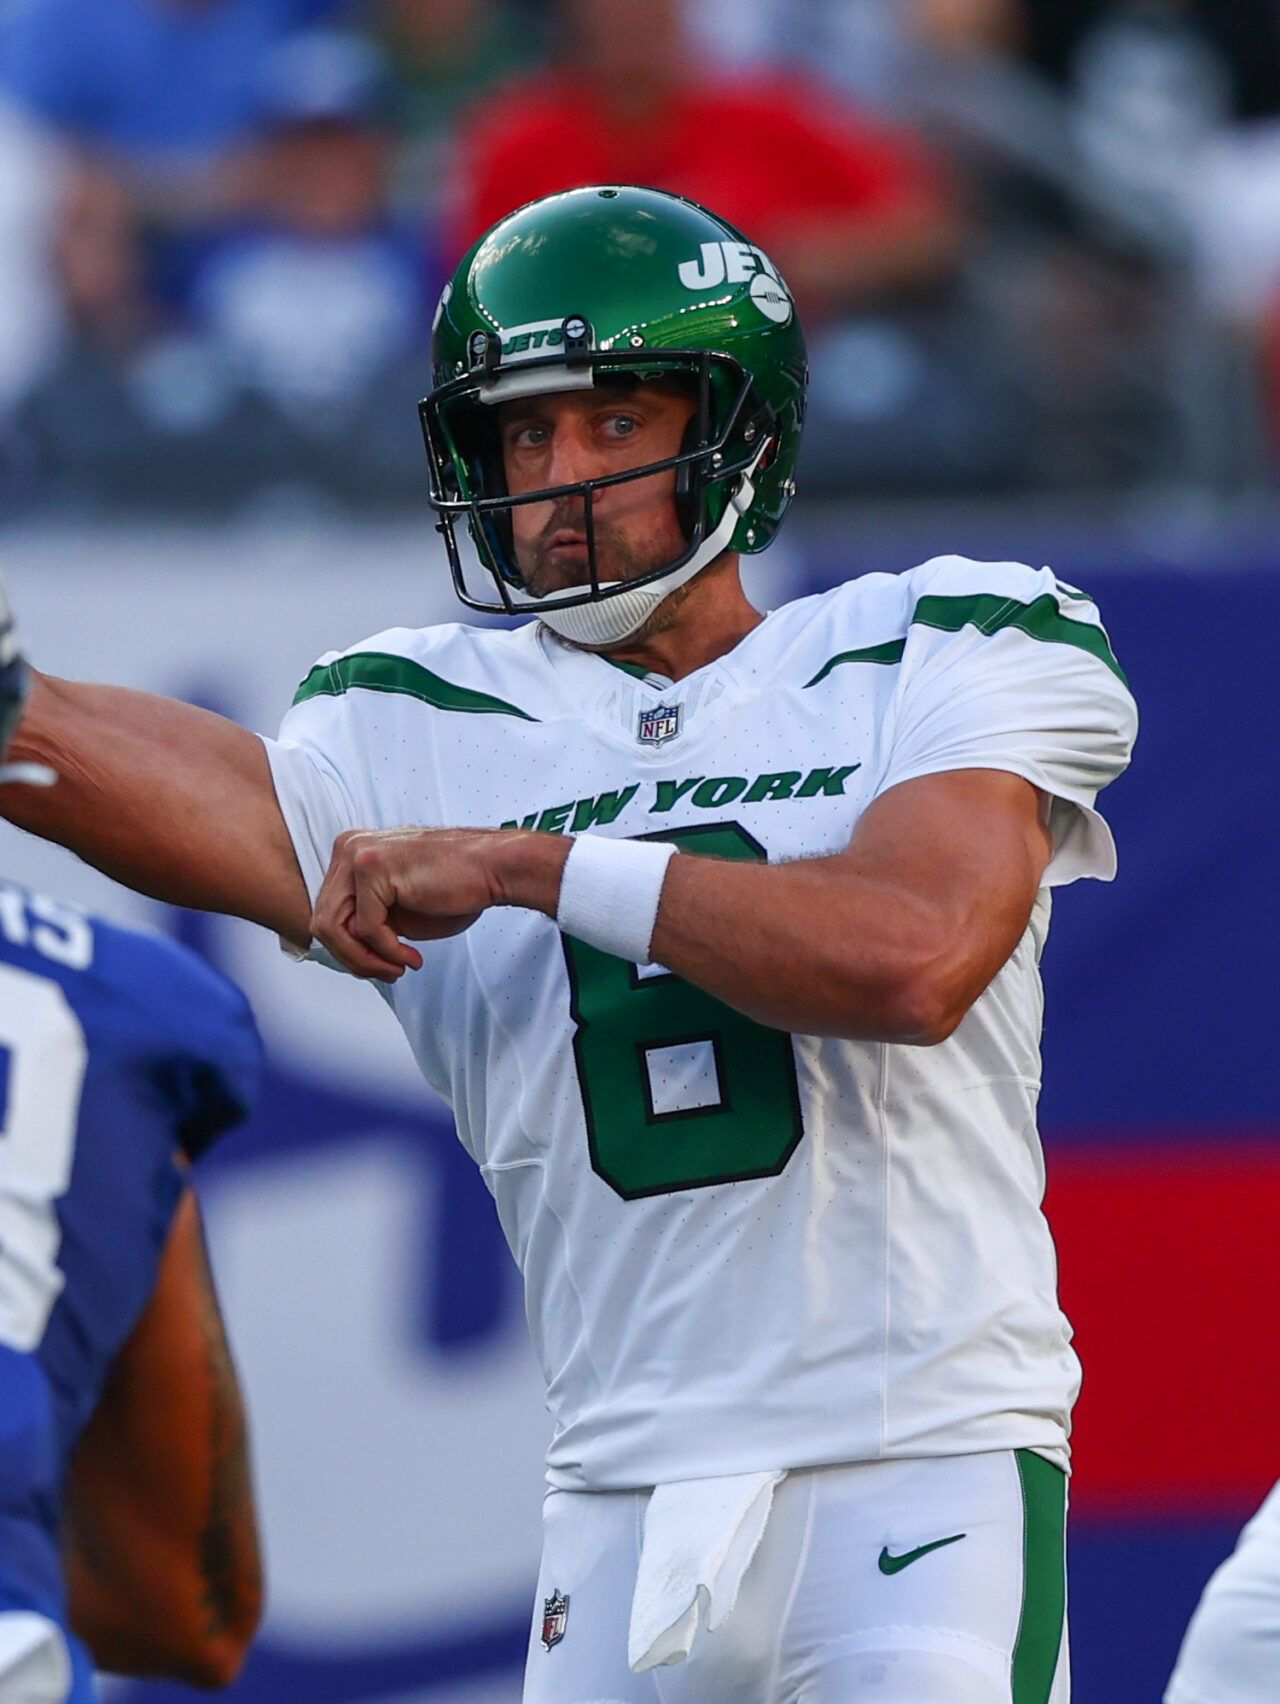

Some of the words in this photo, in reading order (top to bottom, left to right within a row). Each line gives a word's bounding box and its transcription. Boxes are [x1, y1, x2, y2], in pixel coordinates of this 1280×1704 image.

[501, 327, 563, 355] JETS
[642, 719, 674, 738] NFL
[649, 762, 861, 813] YORK
[563, 820, 803, 1200] 8
